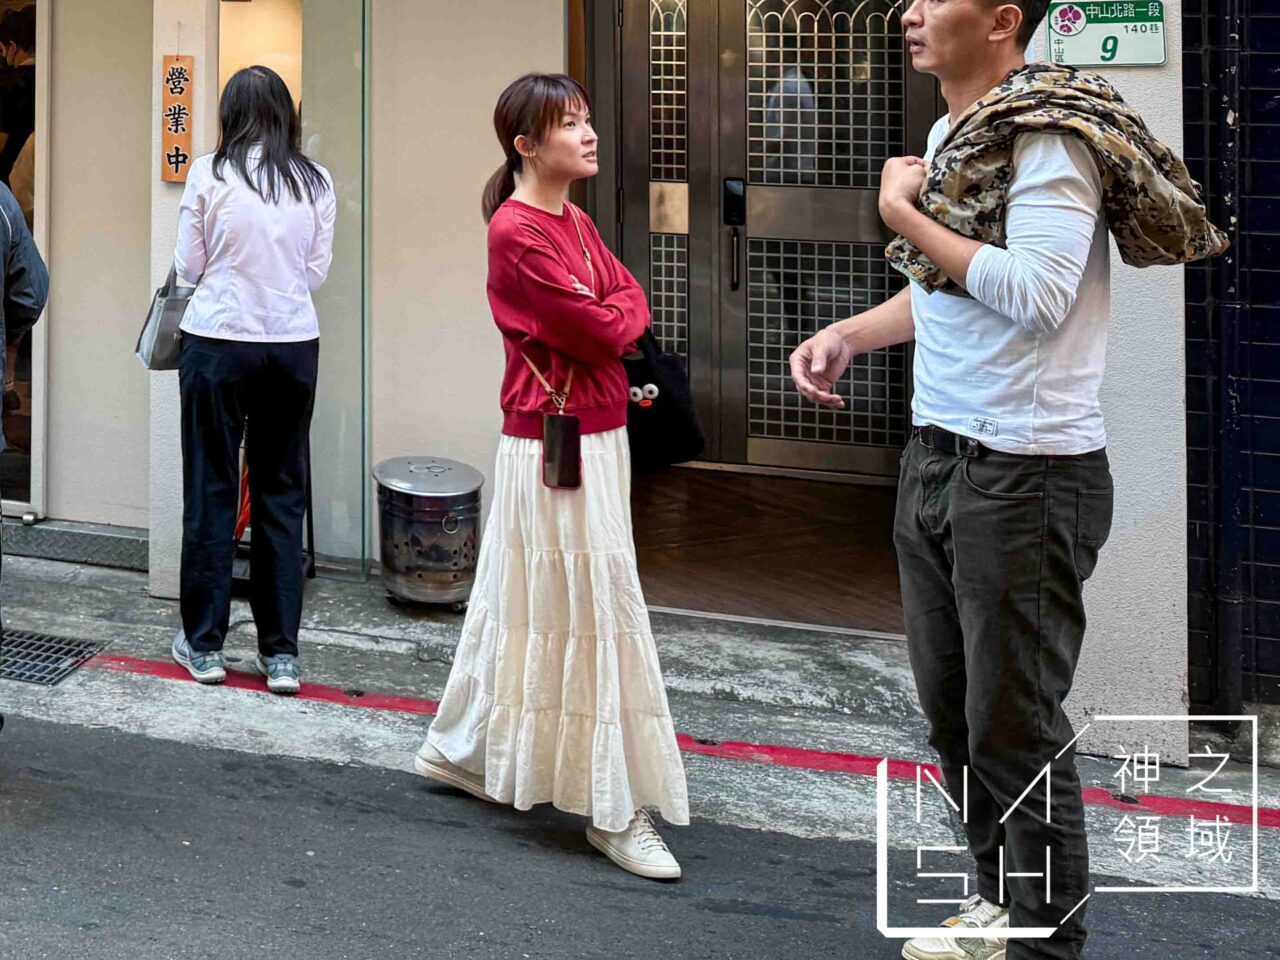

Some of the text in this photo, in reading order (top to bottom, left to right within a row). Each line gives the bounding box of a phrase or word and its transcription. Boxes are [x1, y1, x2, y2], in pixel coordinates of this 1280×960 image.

[1086, 2, 1161, 19] 中山北路一段
[1123, 23, 1160, 34] 140巷
[1100, 35, 1119, 62] 9
[164, 66, 190, 174] 營業中
